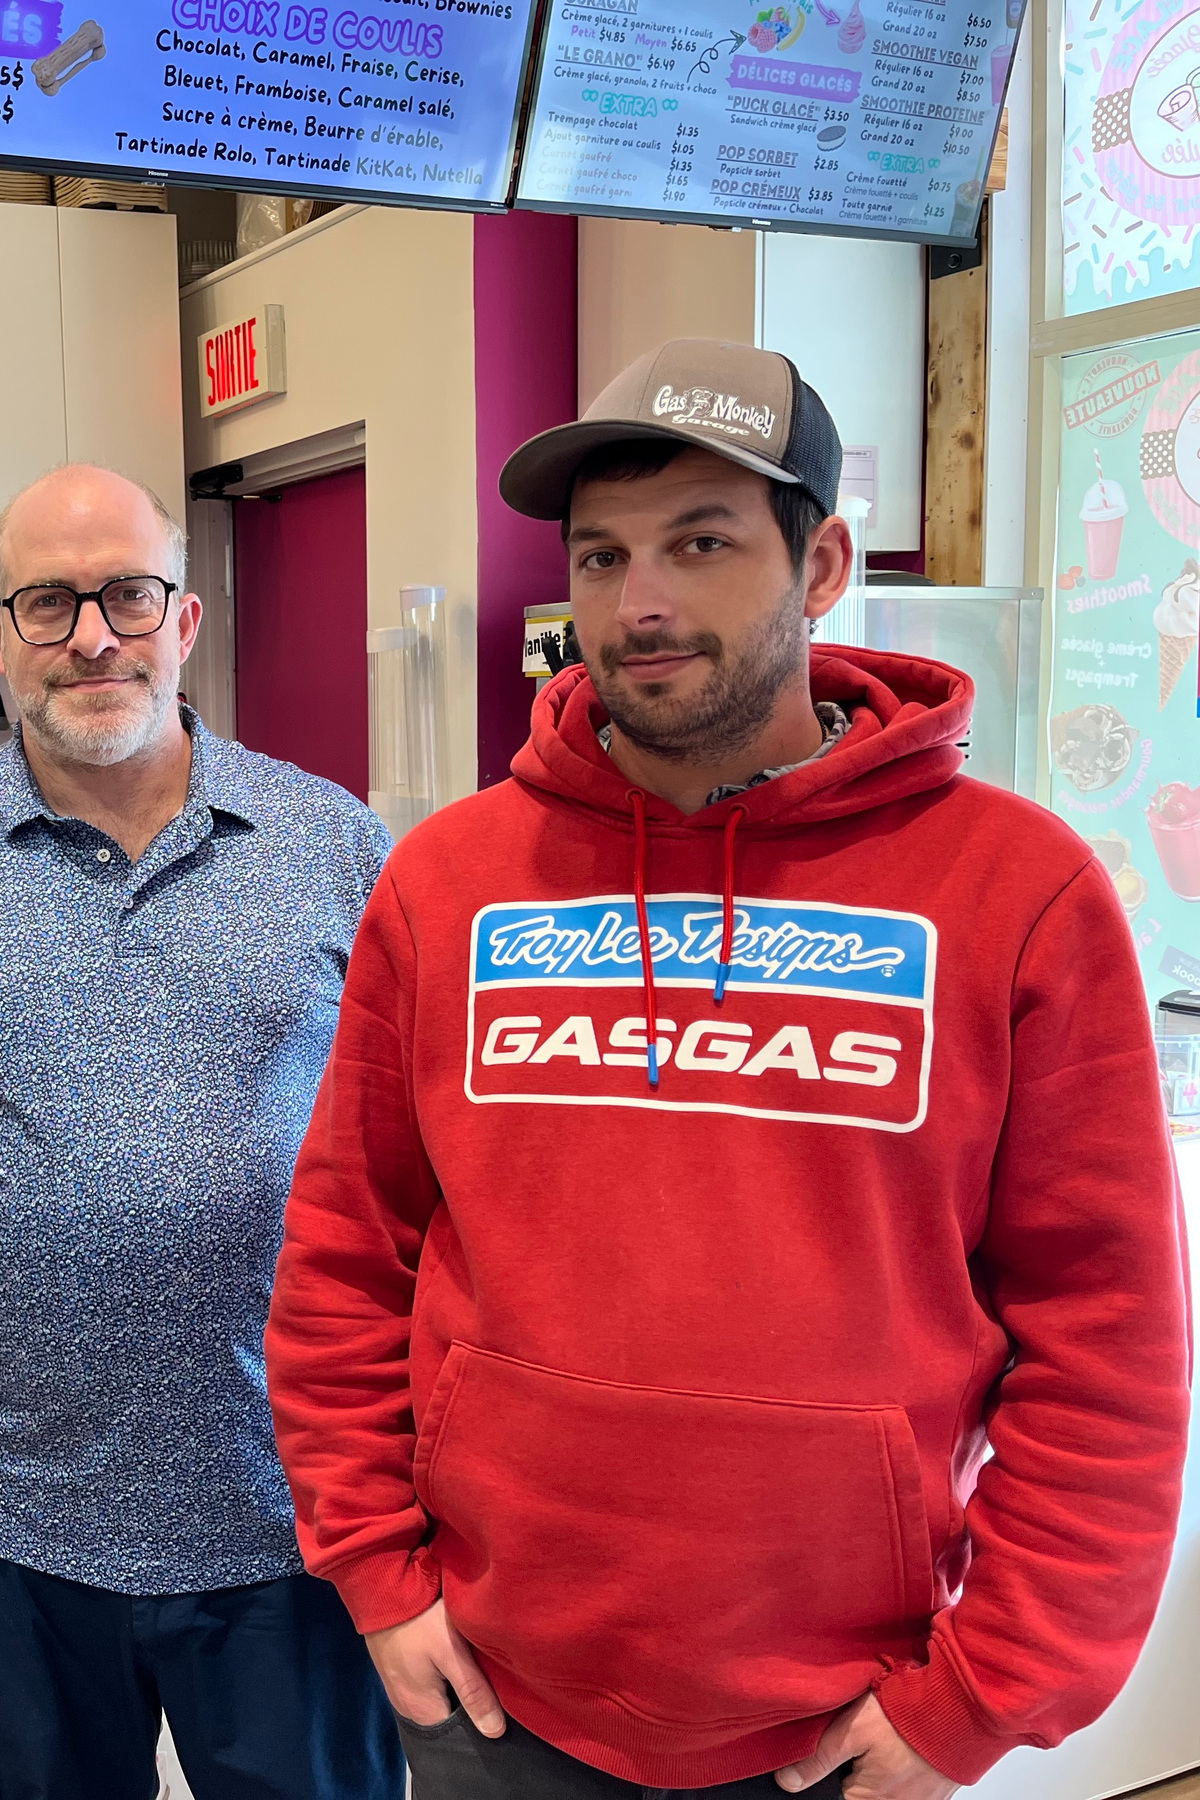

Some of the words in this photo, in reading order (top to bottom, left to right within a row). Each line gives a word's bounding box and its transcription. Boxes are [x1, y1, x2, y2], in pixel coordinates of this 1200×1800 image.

[435, 0, 512, 19] Brownies
[561, 9, 593, 23] Crème
[630, 20, 676, 34] garnitures
[967, 13, 992, 29] $6.50
[171, 0, 279, 38] CHOIX
[284, 8, 328, 46] DE
[332, 15, 444, 59] COULIS
[571, 25, 596, 39] Petit
[599, 28, 626, 43] $4.85
[635, 33, 667, 49] Moyen
[670, 37, 697, 52] $6.65
[883, 21, 912, 35] Grand
[963, 33, 987, 48] $7.50
[156, 29, 246, 60] Chocolat,
[252, 43, 335, 71] Caramel,
[341, 53, 399, 80] Fraise,
[405, 61, 464, 87] Cerise,
[647, 54, 676, 71] $6.49
[872, 40, 936, 61] SMOOTHIE
[939, 49, 979, 67] VEGAN
[164, 65, 228, 94] Bleuet,
[235, 75, 331, 105] Framboise,
[338, 87, 412, 113] Caramel
[418, 97, 455, 119] salé,
[554, 66, 585, 80] Crème
[693, 83, 717, 95] choco
[871, 78, 900, 92] Grand
[960, 71, 984, 87] $7.00
[599, 91, 658, 118] EXTRA
[823, 107, 850, 123] $3.50
[861, 95, 925, 116] SMOOTHIE
[163, 102, 214, 125] Sucre
[238, 112, 298, 137] crème,
[305, 116, 365, 141] Beurre
[549, 112, 596, 129] Trempage
[599, 117, 638, 131] chocolat
[676, 122, 699, 138] $1.35
[730, 115, 768, 130] Sandwich
[672, 140, 695, 155] $1.05
[860, 130, 889, 144] Grand
[115, 132, 208, 158] Tartinade
[213, 142, 257, 166] Rolo,
[265, 148, 351, 174] Tartinade
[357, 156, 418, 181] KitKat,
[422, 163, 483, 186] Nutella
[669, 158, 693, 173] $1.35
[717, 145, 745, 160] POP
[748, 148, 799, 166] SORBET
[813, 156, 839, 172] $2.85
[880, 153, 924, 174] EXTRA
[711, 179, 738, 194] POP
[807, 188, 833, 203] $3.85
[789, 202, 824, 216] Chocolat
[205, 317, 259, 407] SORTIE
[652, 384, 688, 416] Gas
[711, 393, 776, 439] Monkey
[490, 914, 590, 973] Troy
[582, 911, 678, 962] Lee
[678, 910, 905, 979] Designs
[481, 1015, 902, 1087] GASGAS
